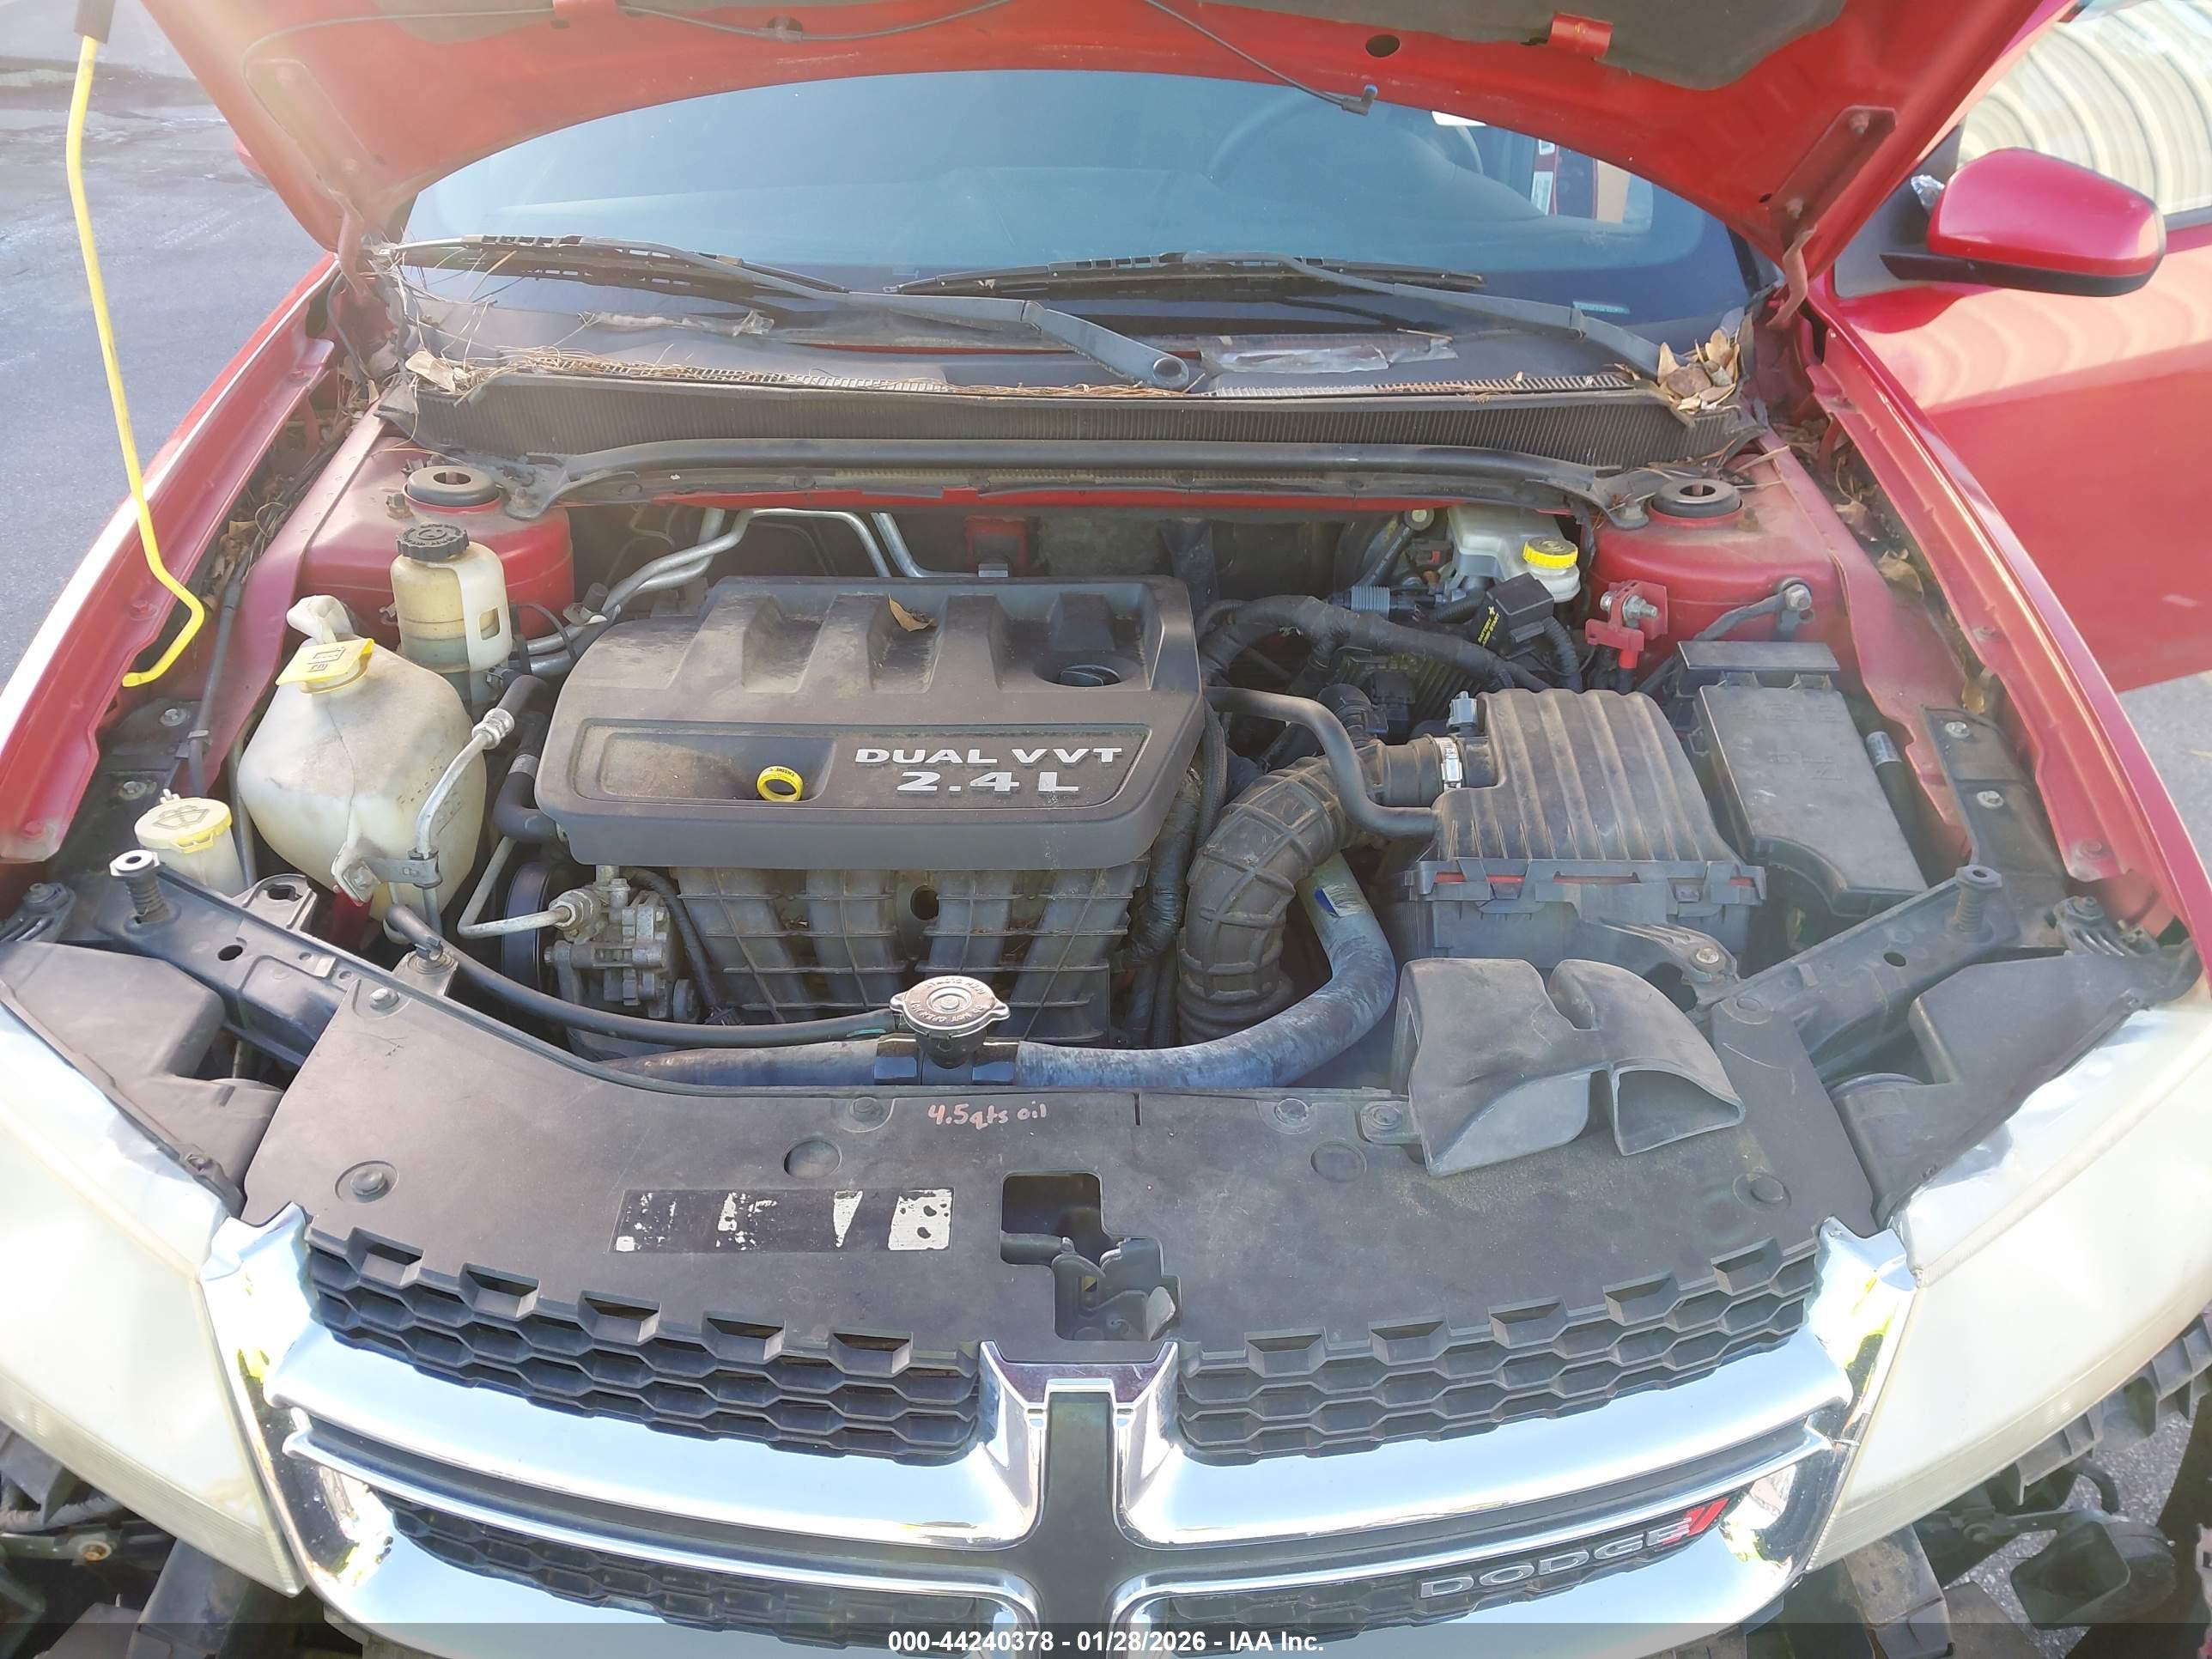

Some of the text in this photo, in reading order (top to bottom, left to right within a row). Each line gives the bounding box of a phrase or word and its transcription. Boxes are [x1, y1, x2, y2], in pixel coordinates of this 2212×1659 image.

[854, 748, 1122, 763] DUAL VVT
[1017, 1100, 1047, 1121] oil
[1420, 1517, 1692, 1599] DODGE
